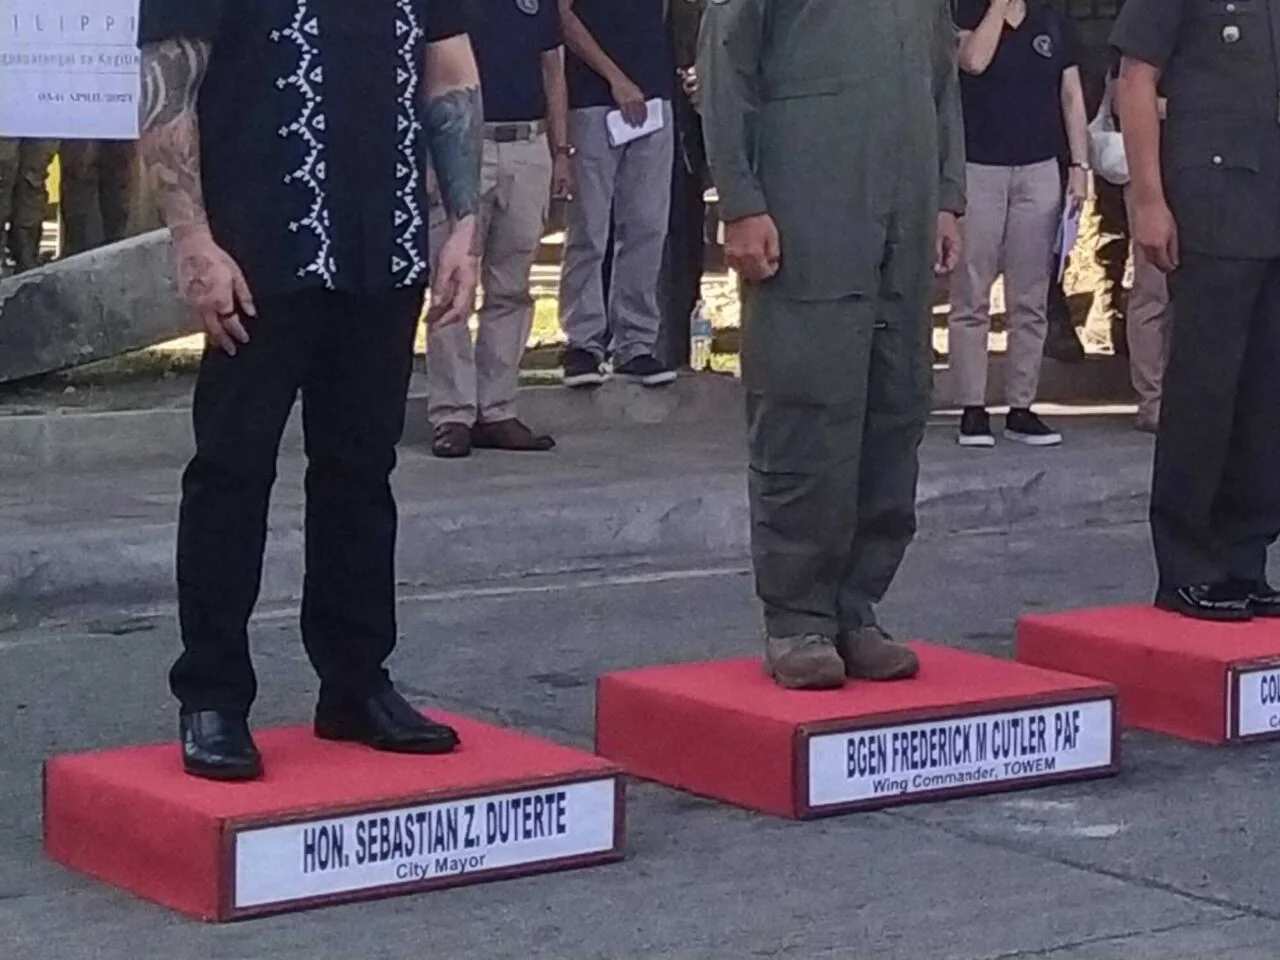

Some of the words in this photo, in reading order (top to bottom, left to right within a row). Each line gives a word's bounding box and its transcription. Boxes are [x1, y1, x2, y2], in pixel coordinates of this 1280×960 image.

[846, 733, 887, 779] BGEN
[890, 724, 973, 772] FREDERICK
[976, 721, 988, 763] M
[992, 714, 1047, 760] CUTLER
[1054, 710, 1080, 751] PAF
[872, 777, 908, 794] Wing
[912, 767, 998, 788] Commander,
[1003, 757, 1056, 777] TOWEM
[303, 824, 349, 873] HON.
[355, 806, 458, 865] SEBASTIAN
[463, 804, 480, 848] Z.
[486, 791, 567, 846] DUTERTE
[395, 860, 429, 882] City
[434, 854, 486, 877] Mayor
